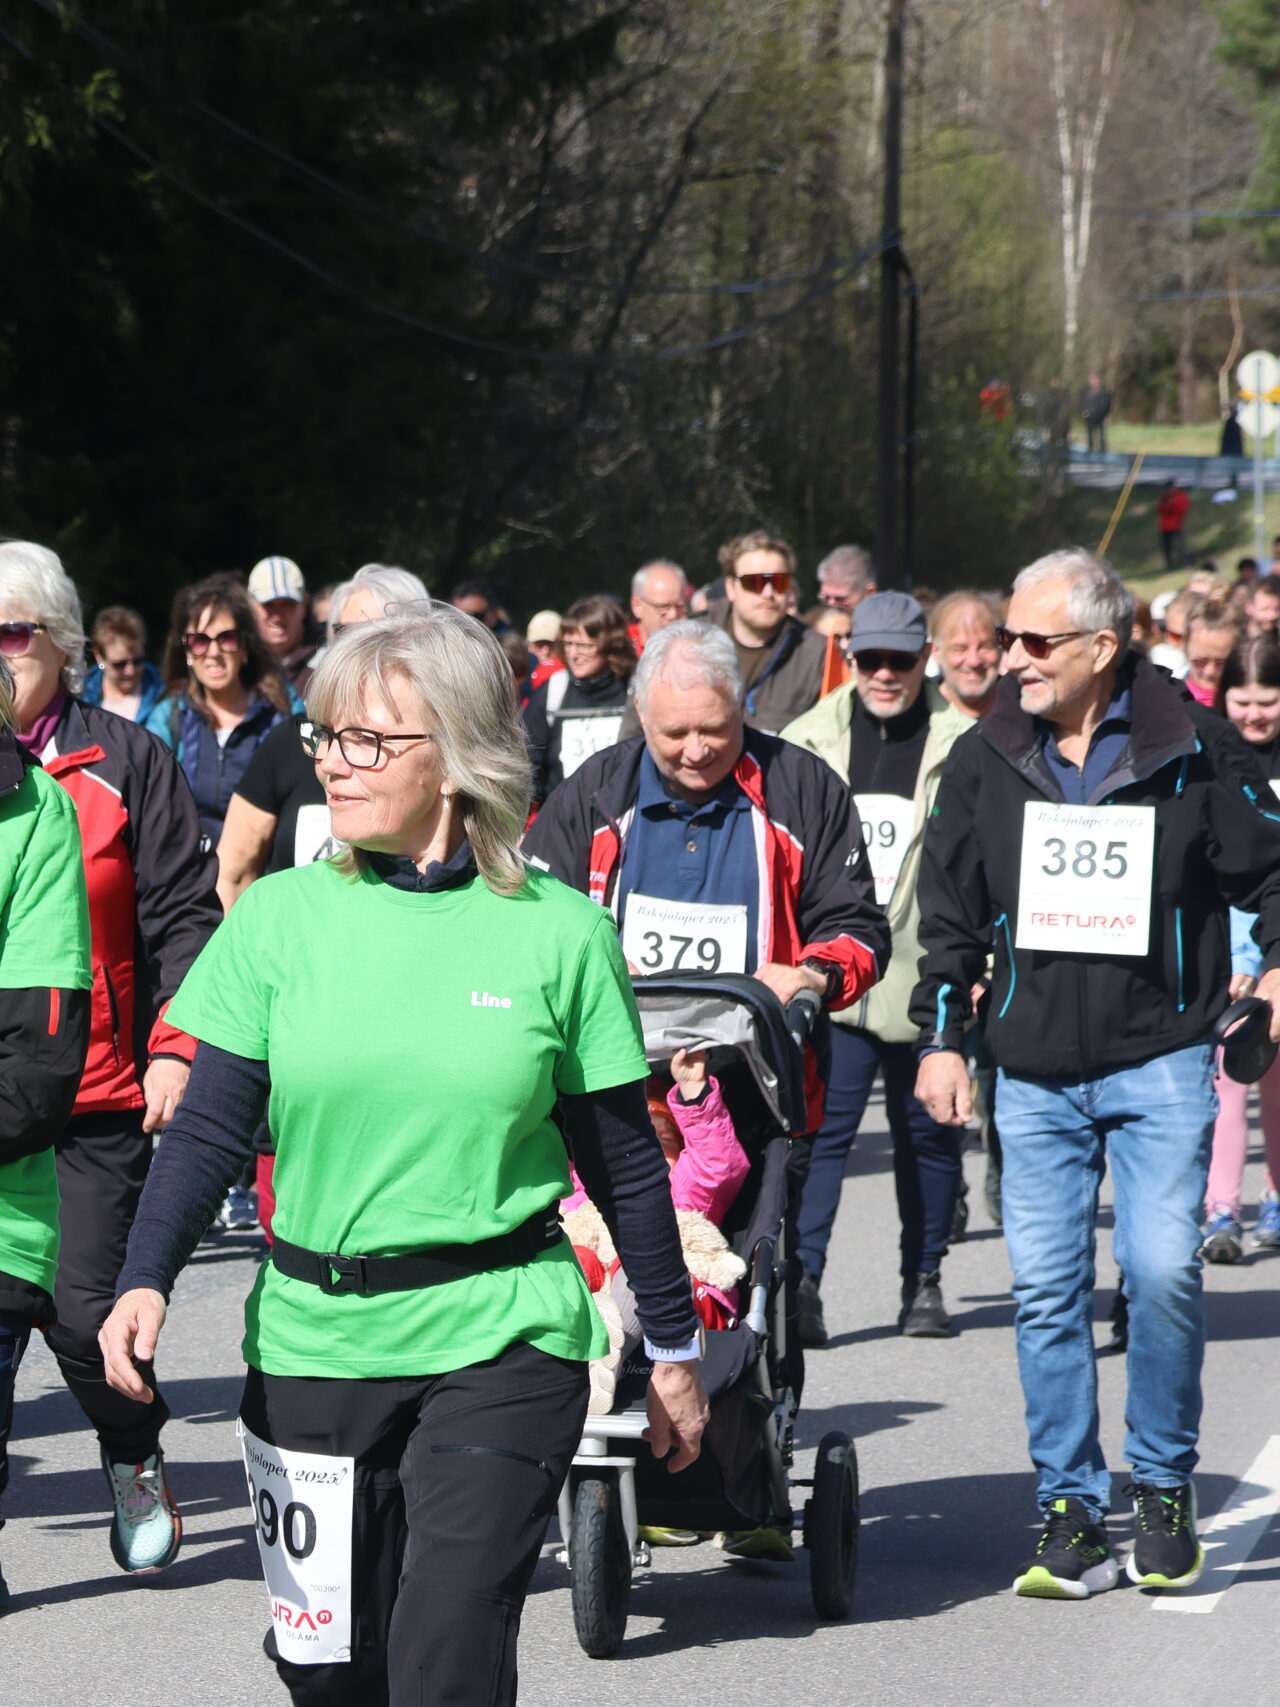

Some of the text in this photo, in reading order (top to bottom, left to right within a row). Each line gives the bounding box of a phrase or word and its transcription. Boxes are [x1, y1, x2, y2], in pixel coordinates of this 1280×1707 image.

[1041, 838, 1128, 879] 385
[1031, 912, 1126, 930] RETURA
[640, 931, 722, 974] 379
[471, 991, 512, 1009] Line
[294, 1469, 338, 1485] 2025
[248, 1473, 317, 1560] 90
